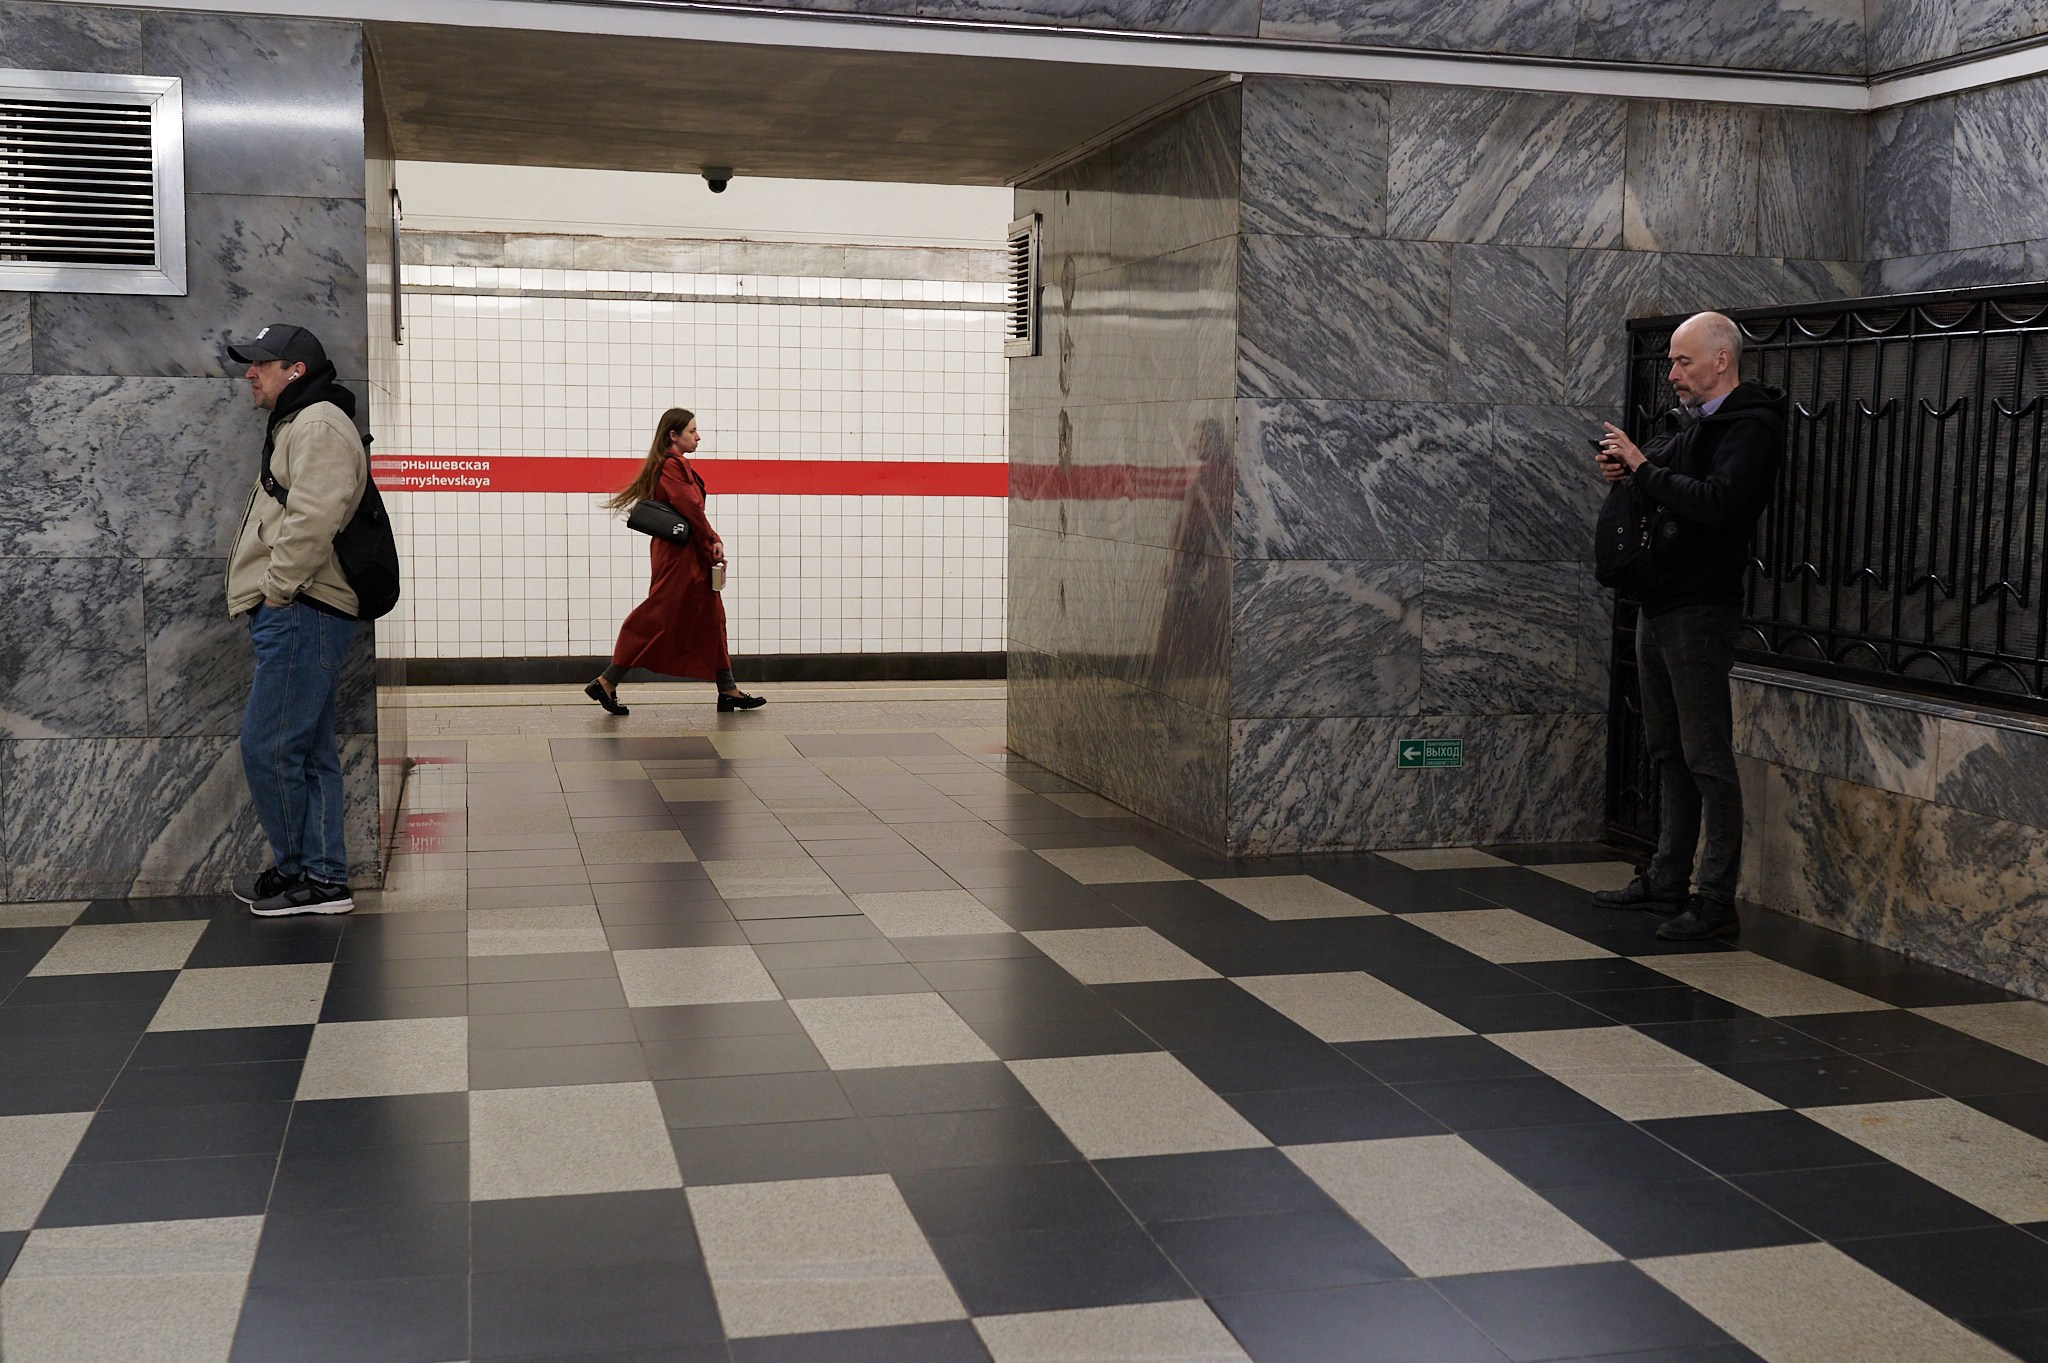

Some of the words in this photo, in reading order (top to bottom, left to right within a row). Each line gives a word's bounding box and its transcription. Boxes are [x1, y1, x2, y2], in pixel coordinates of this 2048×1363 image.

[401, 460, 490, 472] рнышевская
[401, 474, 490, 488] ernyshevskaya
[1426, 746, 1460, 758] ВЫХОД
